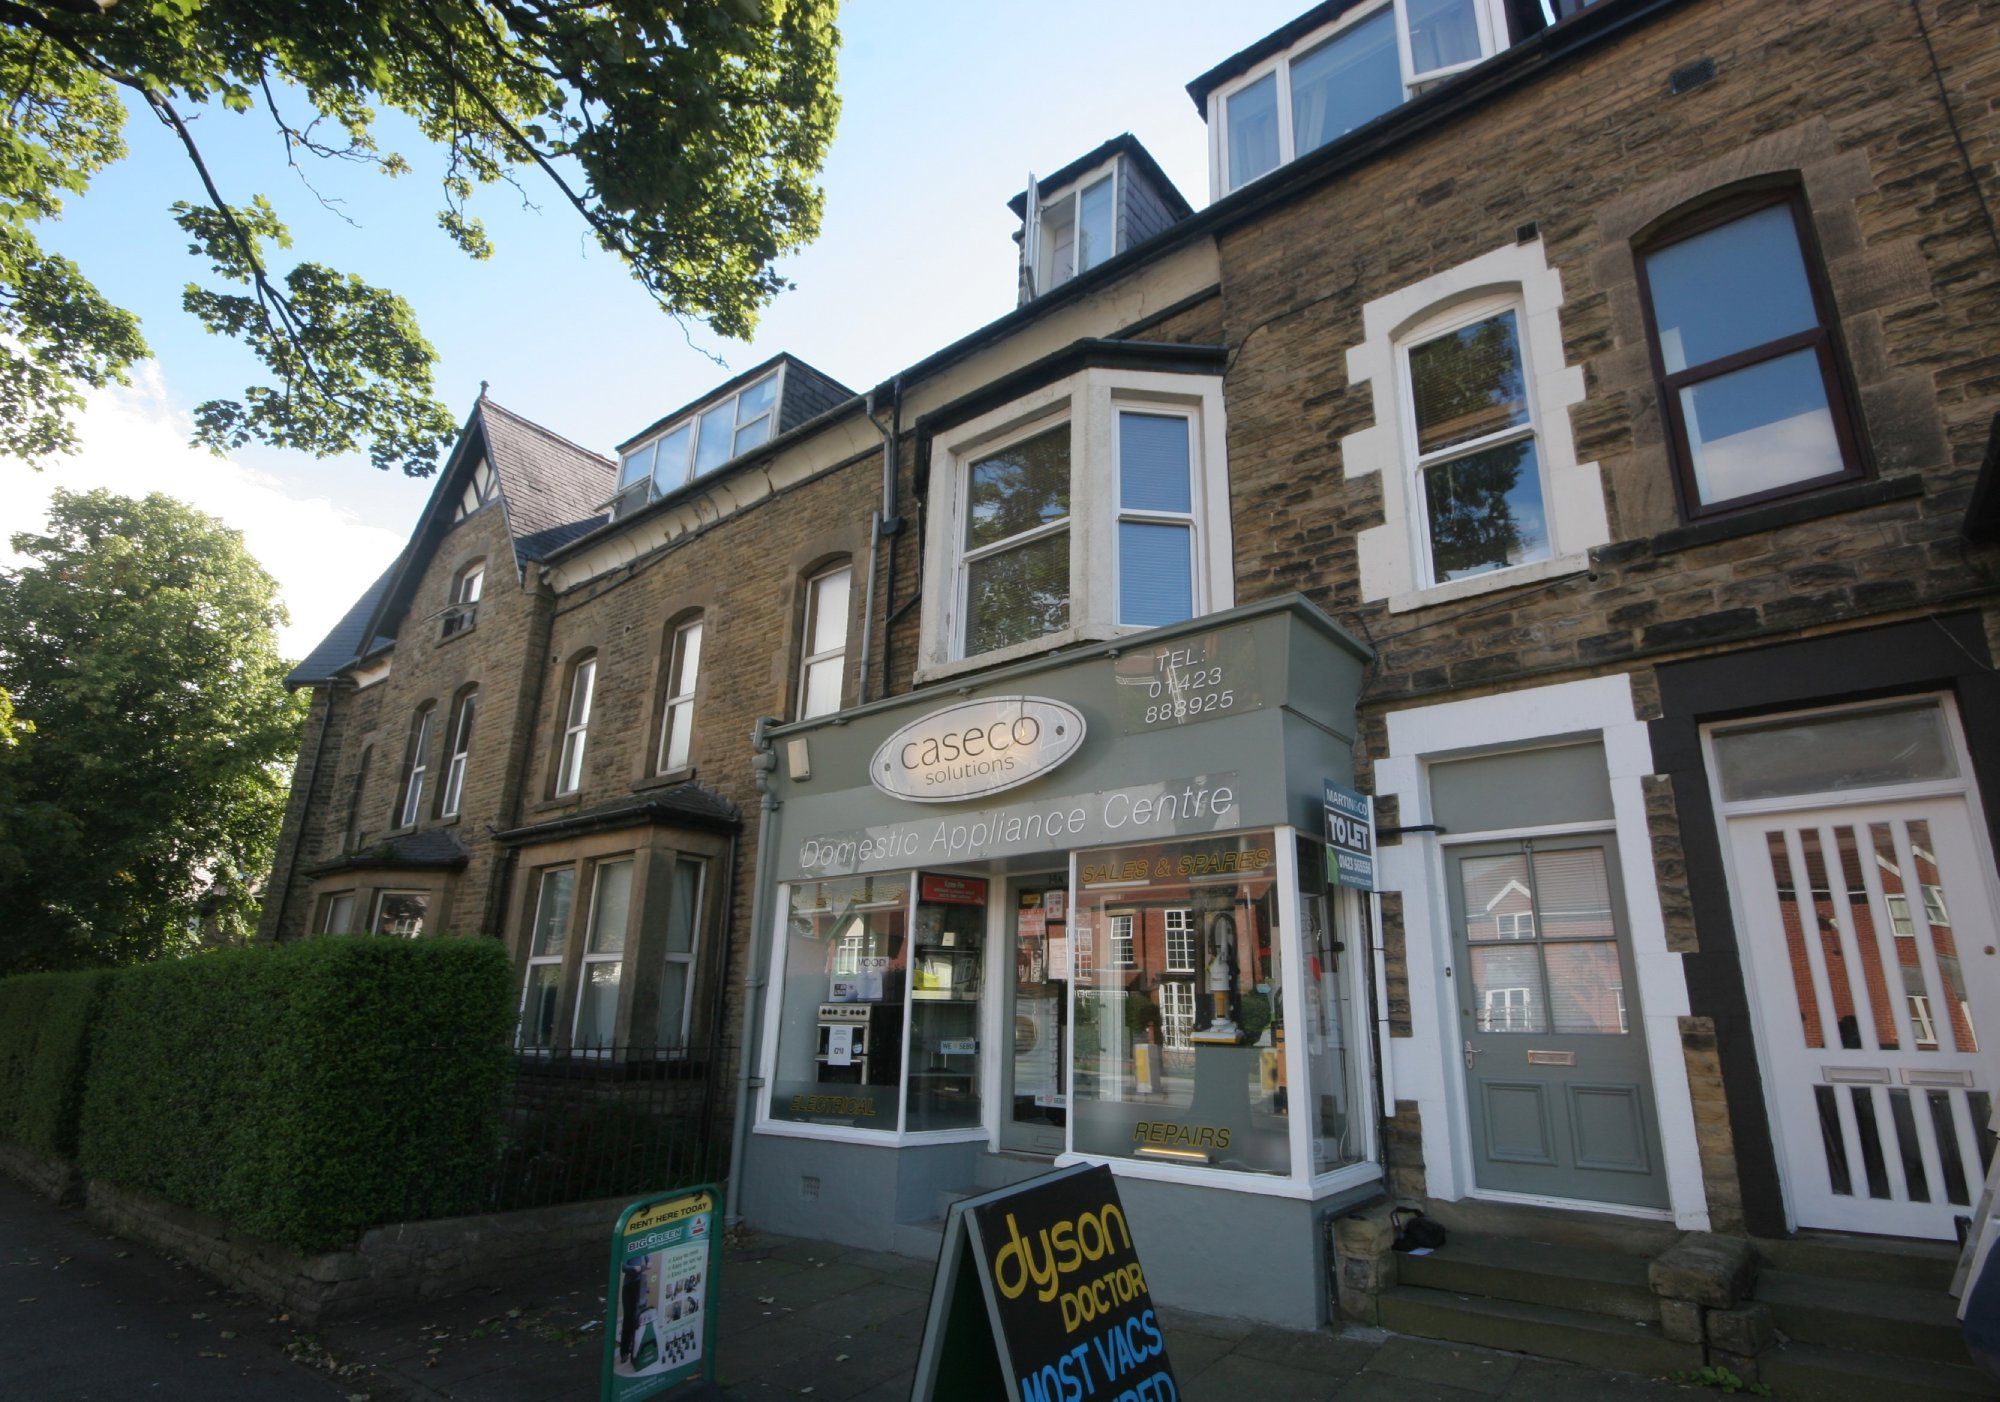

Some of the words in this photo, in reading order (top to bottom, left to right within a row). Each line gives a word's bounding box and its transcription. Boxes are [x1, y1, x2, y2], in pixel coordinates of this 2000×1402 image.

[1156, 647, 1206, 672] TEL:
[1149, 667, 1222, 698] 01423
[1145, 690, 1234, 723] 888925
[901, 716, 1040, 770] caseco
[925, 756, 1016, 786] solutions
[801, 827, 919, 869] Domestic
[930, 808, 1086, 858] Appliance
[1104, 785, 1234, 829] Centre
[1328, 813, 1347, 843] TO
[1347, 820, 1368, 850] LET
[1081, 858, 1150, 884] SALES
[1155, 858, 1171, 879] &
[1178, 848, 1271, 875] SPARES
[791, 1094, 878, 1117] ELECTRICAL
[1132, 1120, 1232, 1149] REPAIRS
[629, 1218, 654, 1232] RENT
[655, 1210, 680, 1223] HERE
[680, 1202, 708, 1216] TODAY
[995, 1203, 1131, 1303] dyson
[1060, 1262, 1148, 1334] DOCTOR
[1021, 1342, 1096, 1402] MOST
[1093, 1309, 1164, 1383] VACS
